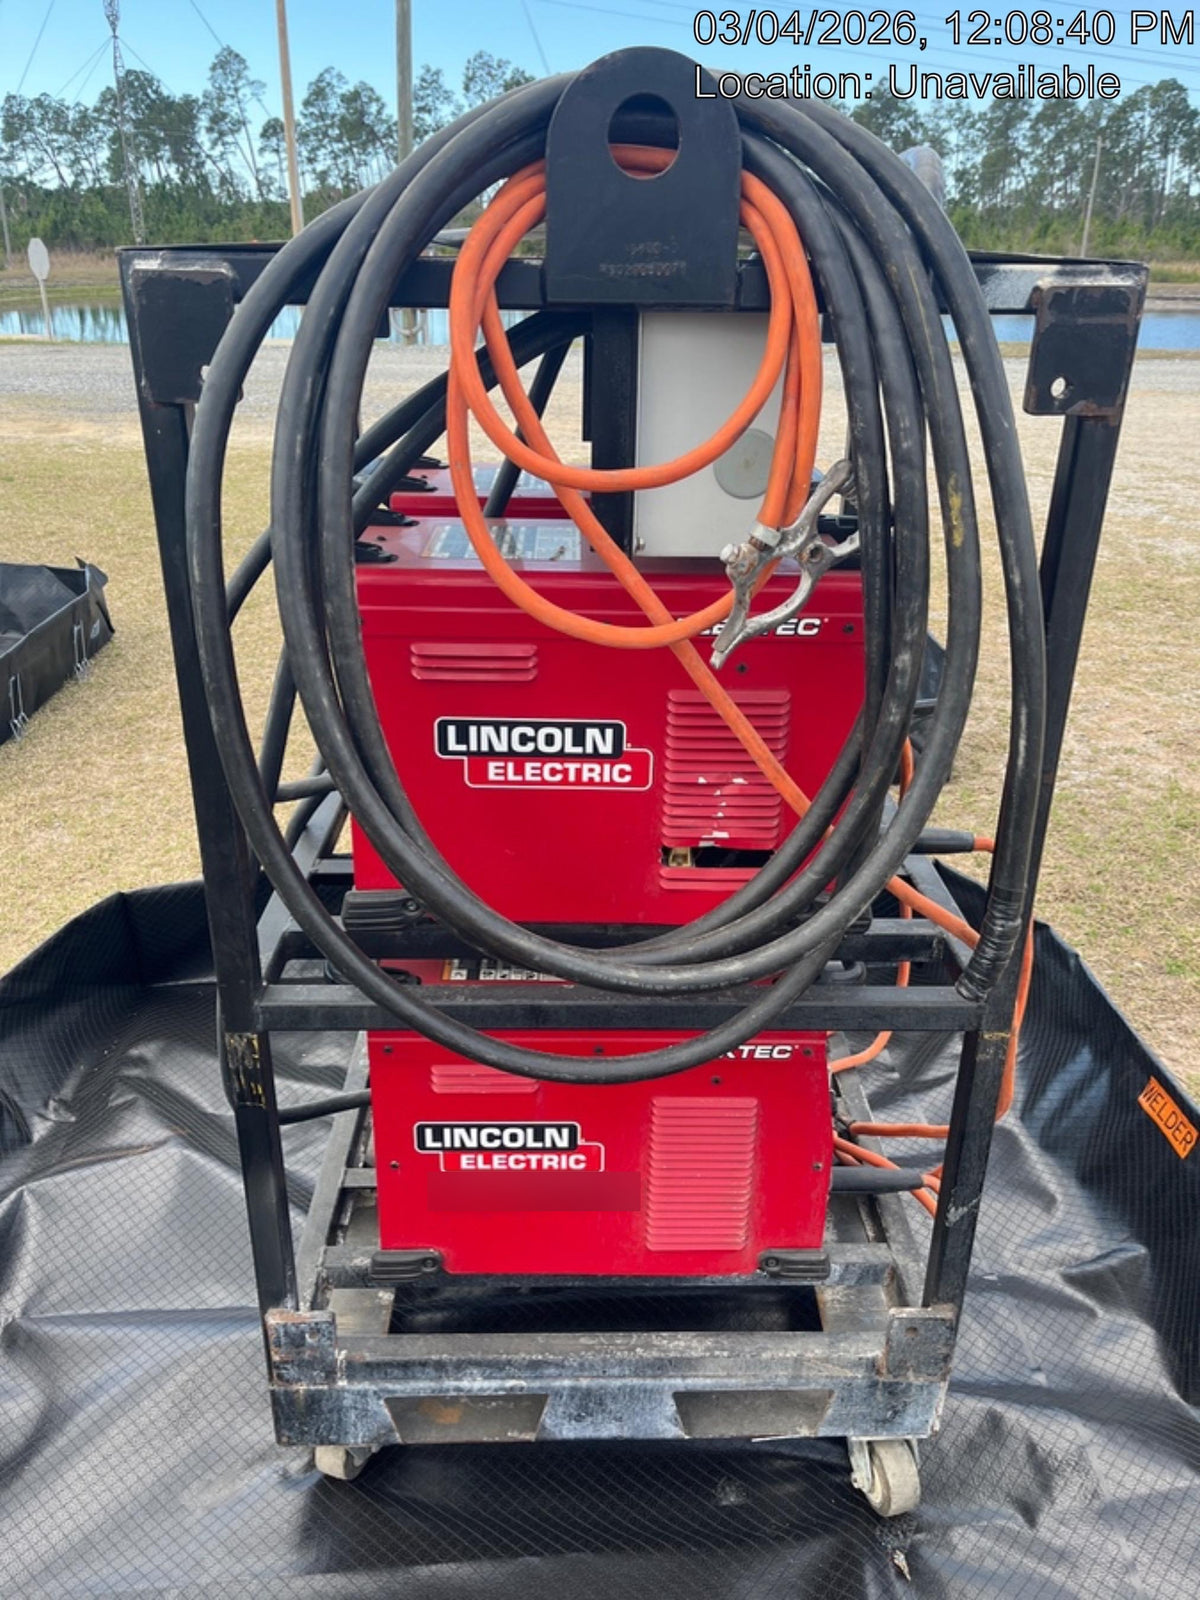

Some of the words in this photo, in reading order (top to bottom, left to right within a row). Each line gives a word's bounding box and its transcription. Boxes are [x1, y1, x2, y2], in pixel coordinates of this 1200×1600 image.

[447, 725, 614, 754] LINCOLN
[487, 761, 632, 783] ELECTRIC
[424, 1127, 569, 1148] LINCOLN
[460, 1154, 587, 1170] ELECTRIC
